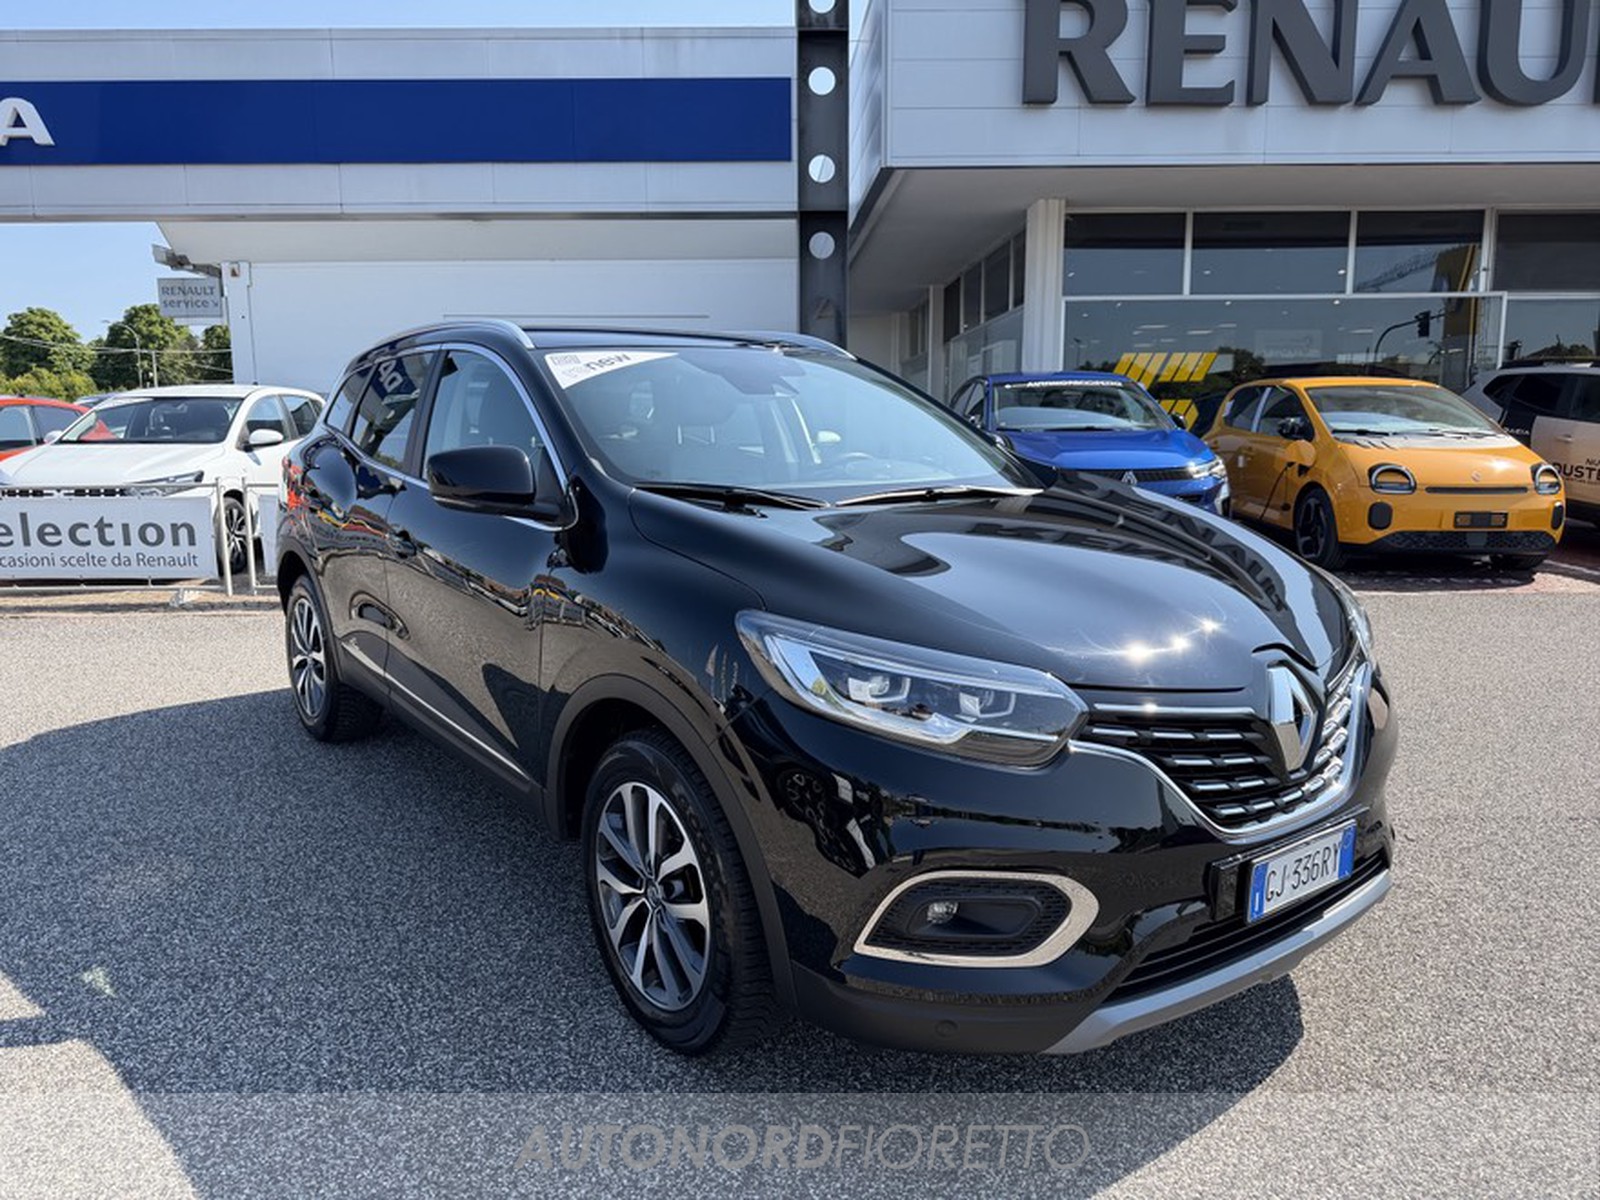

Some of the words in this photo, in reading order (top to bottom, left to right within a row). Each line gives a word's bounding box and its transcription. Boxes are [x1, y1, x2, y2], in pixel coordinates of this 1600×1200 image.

[1022, 0, 1600, 107] RENAU
[161, 286, 215, 296] RENAULT
[162, 299, 210, 309] service
[60, 552, 107, 567] scelte
[111, 552, 132, 567] da
[136, 552, 199, 567] Renault
